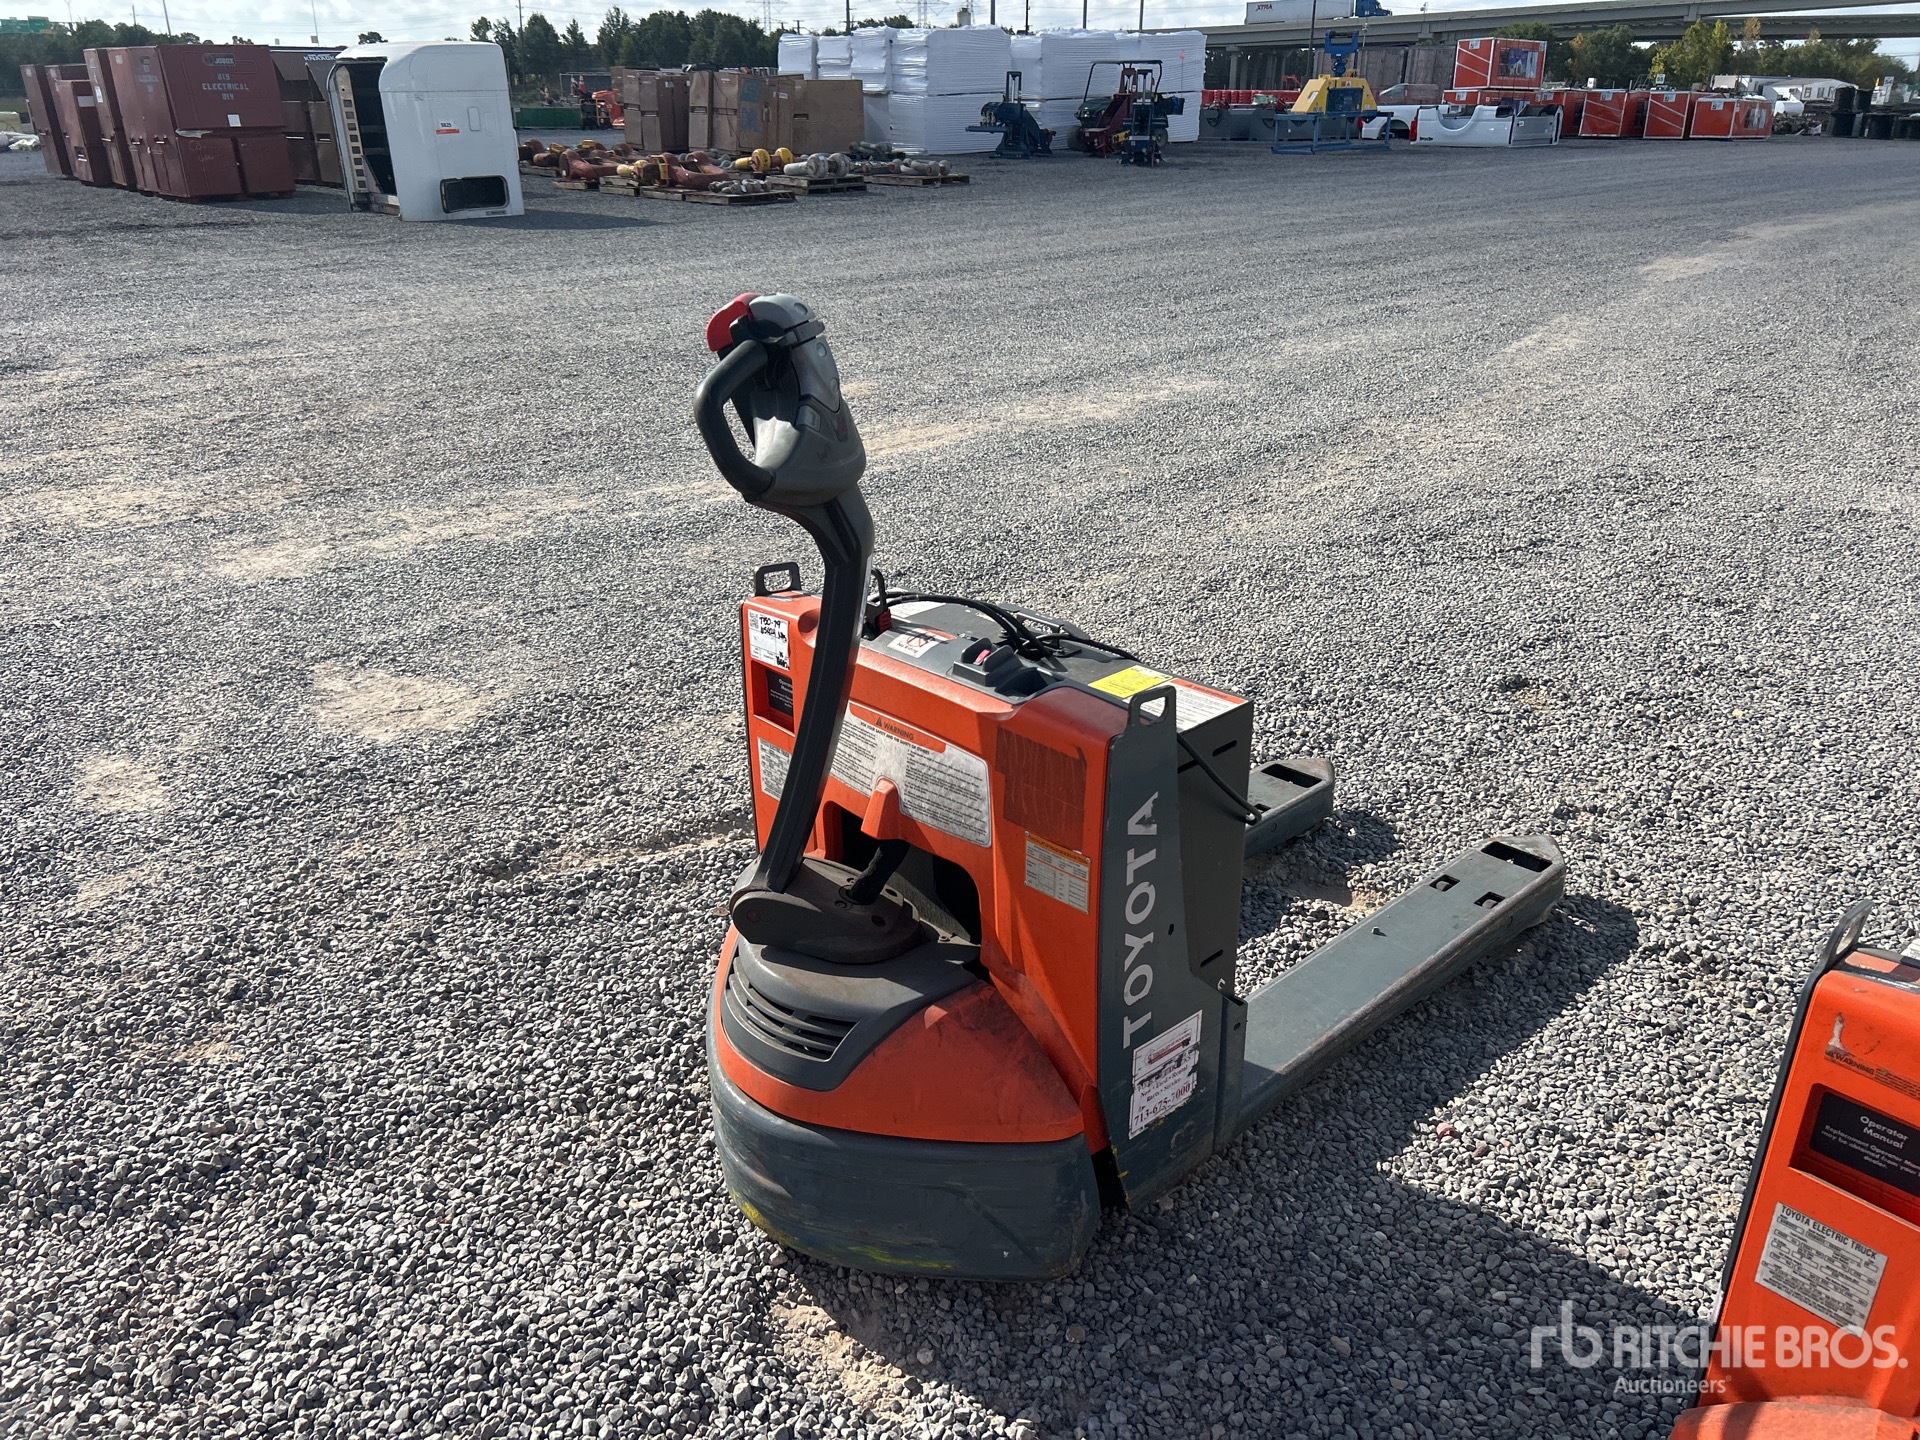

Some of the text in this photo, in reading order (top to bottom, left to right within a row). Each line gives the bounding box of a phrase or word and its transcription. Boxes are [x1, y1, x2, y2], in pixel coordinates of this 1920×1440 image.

[202, 82, 248, 91] ELECTRICAL
[884, 722, 914, 741] WARNING
[1123, 791, 1159, 1050] TOYOTA
[1835, 1053, 1874, 1076] WARNING
[1134, 1083, 1191, 1126] 713-675-7000
[1825, 1124, 1869, 1147] Replacement
[1870, 1144, 1902, 1162] Operator
[1859, 1115, 1909, 1141] Operator
[1863, 1126, 1905, 1149] Manual
[1820, 1130, 1837, 1141] may
[1838, 1136, 1848, 1145] be
[1848, 1142, 1880, 1159] obtained
[1899, 1165, 1917, 1175] your
[1781, 1205, 1877, 1260] TOYOTA ELECTRIC TRUCK
